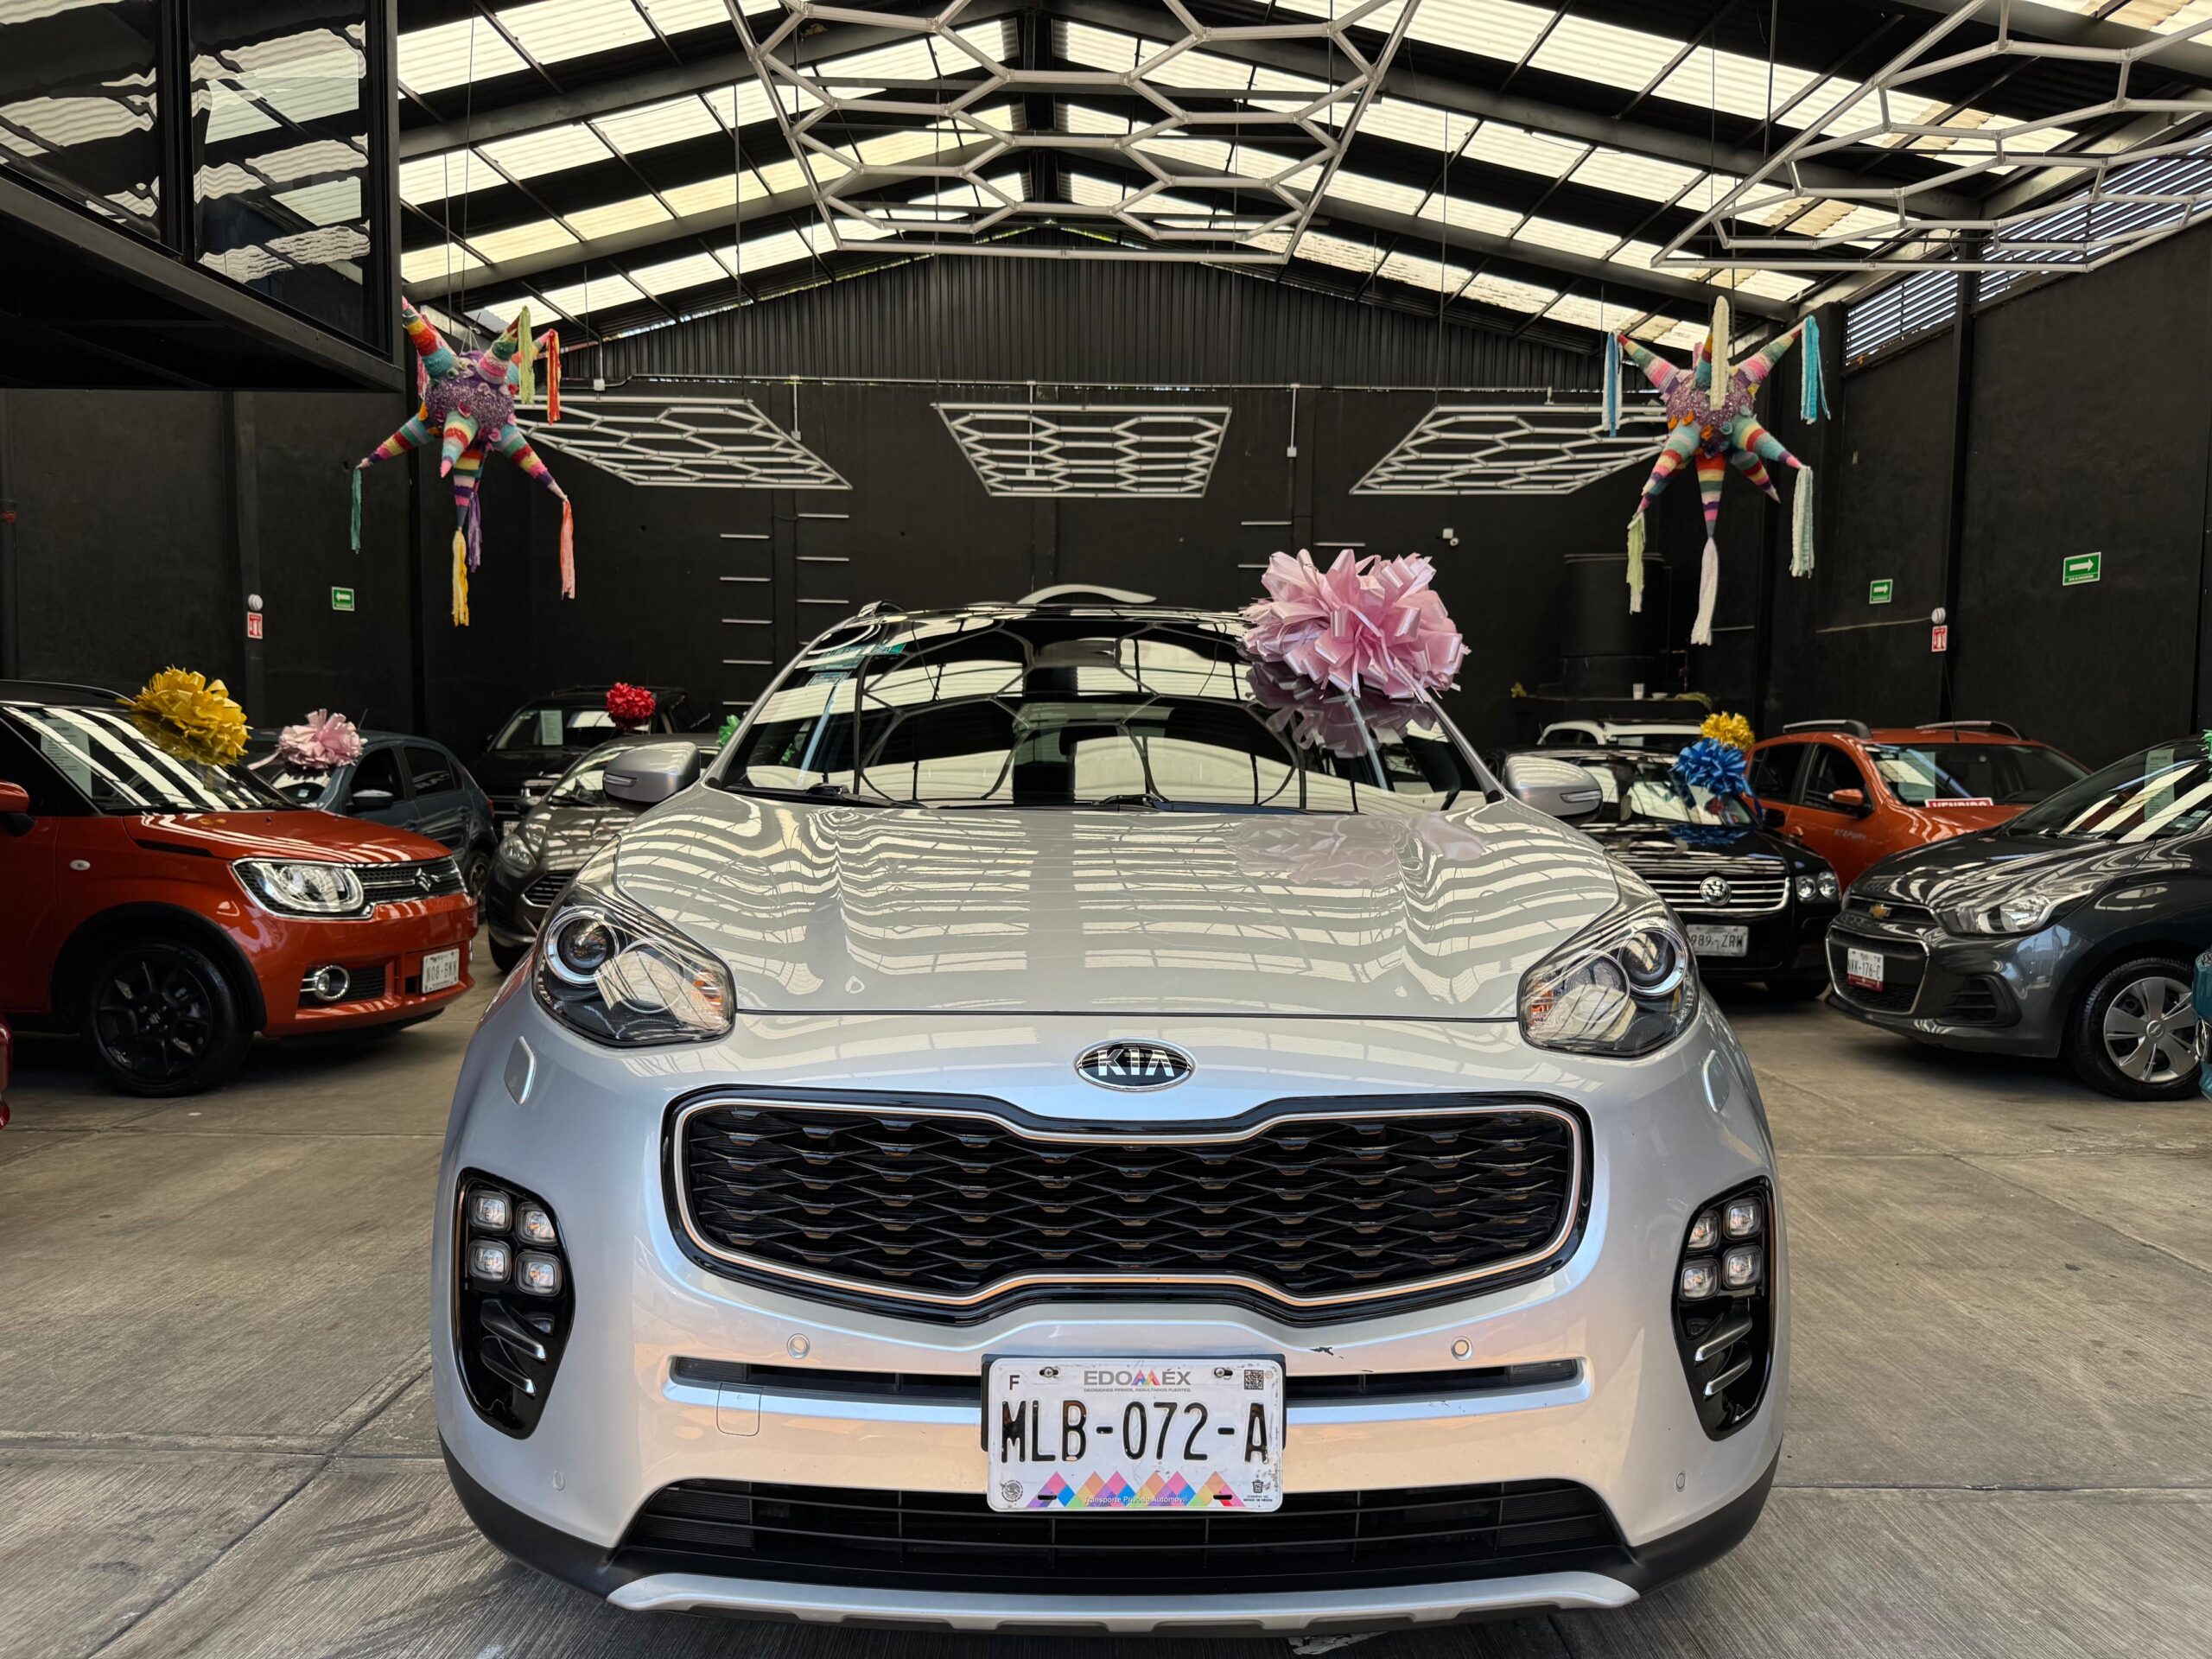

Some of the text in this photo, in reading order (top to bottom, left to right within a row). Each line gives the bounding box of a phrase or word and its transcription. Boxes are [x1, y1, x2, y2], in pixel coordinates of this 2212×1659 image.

[1096, 1048, 1175, 1077] KIA
[1009, 1375, 1020, 1390] F
[1001, 1400, 1269, 1465] MLB-072-A
